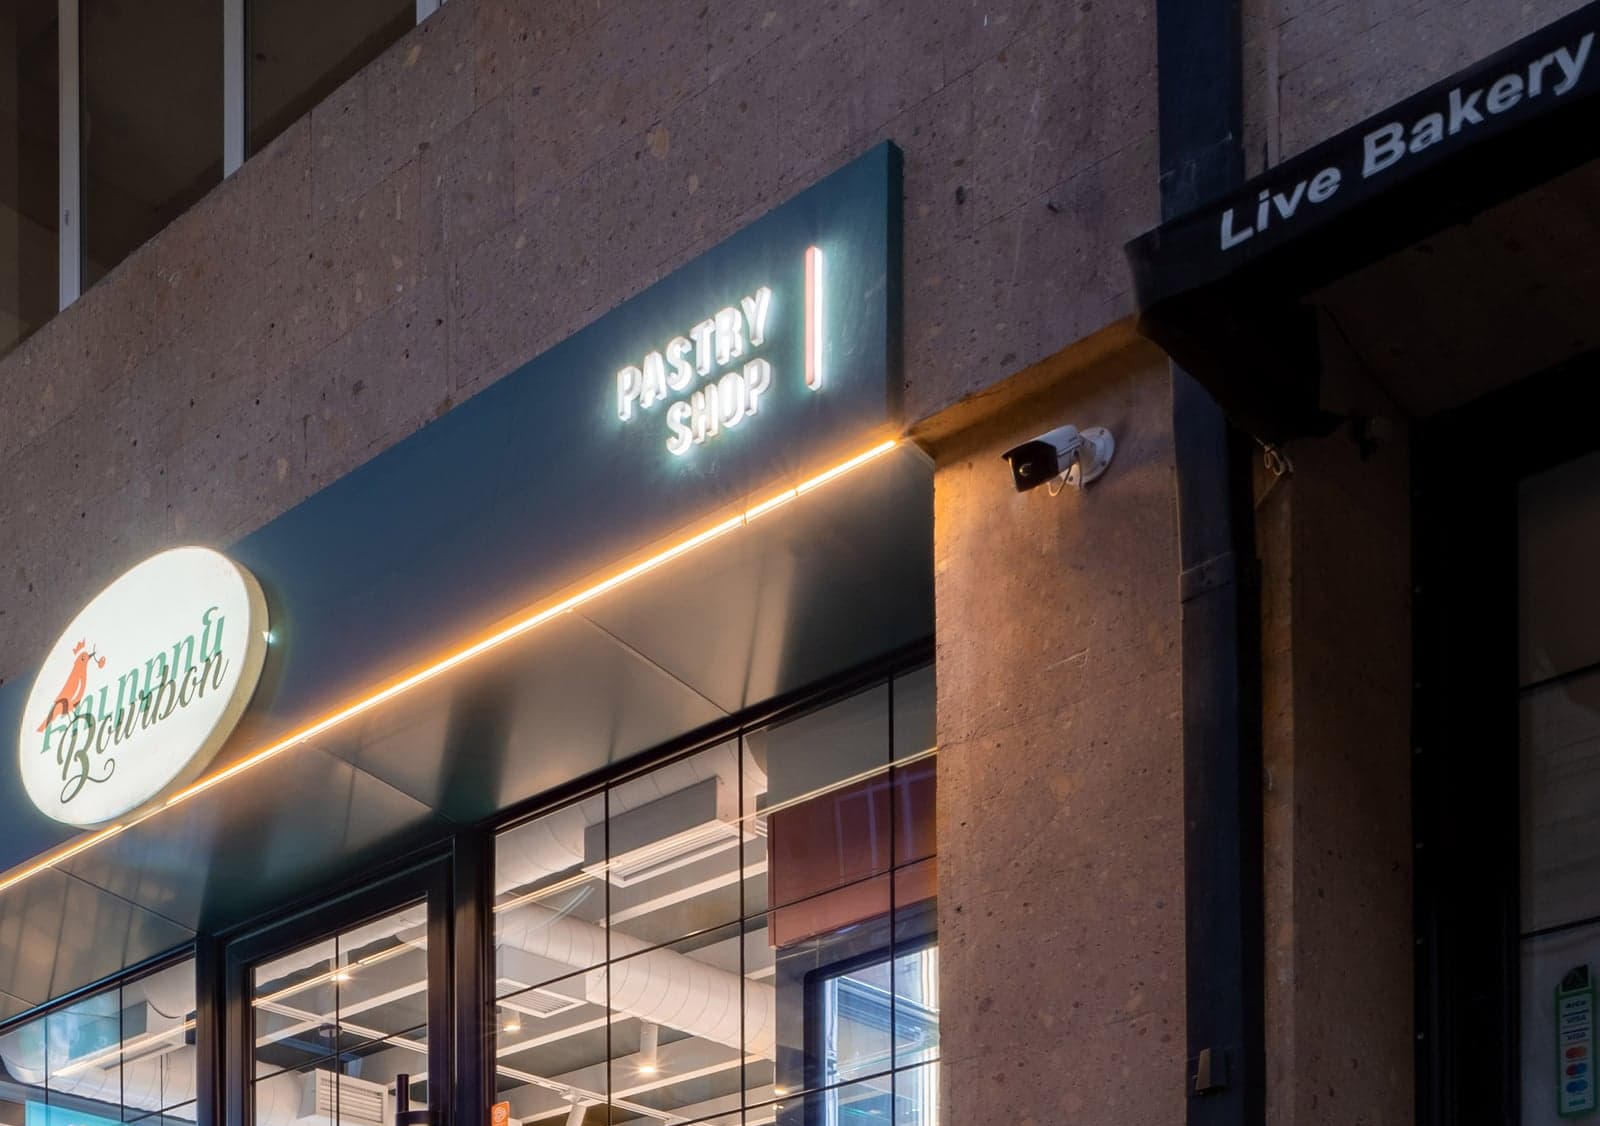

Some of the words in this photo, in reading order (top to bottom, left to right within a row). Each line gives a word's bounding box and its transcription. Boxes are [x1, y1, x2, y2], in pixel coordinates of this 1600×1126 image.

[1220, 167, 1341, 251] Live
[1362, 32, 1596, 179] Bakery
[616, 286, 773, 422] PASTRY
[666, 358, 772, 456] SHOP
[56, 651, 229, 804] Bourbon
